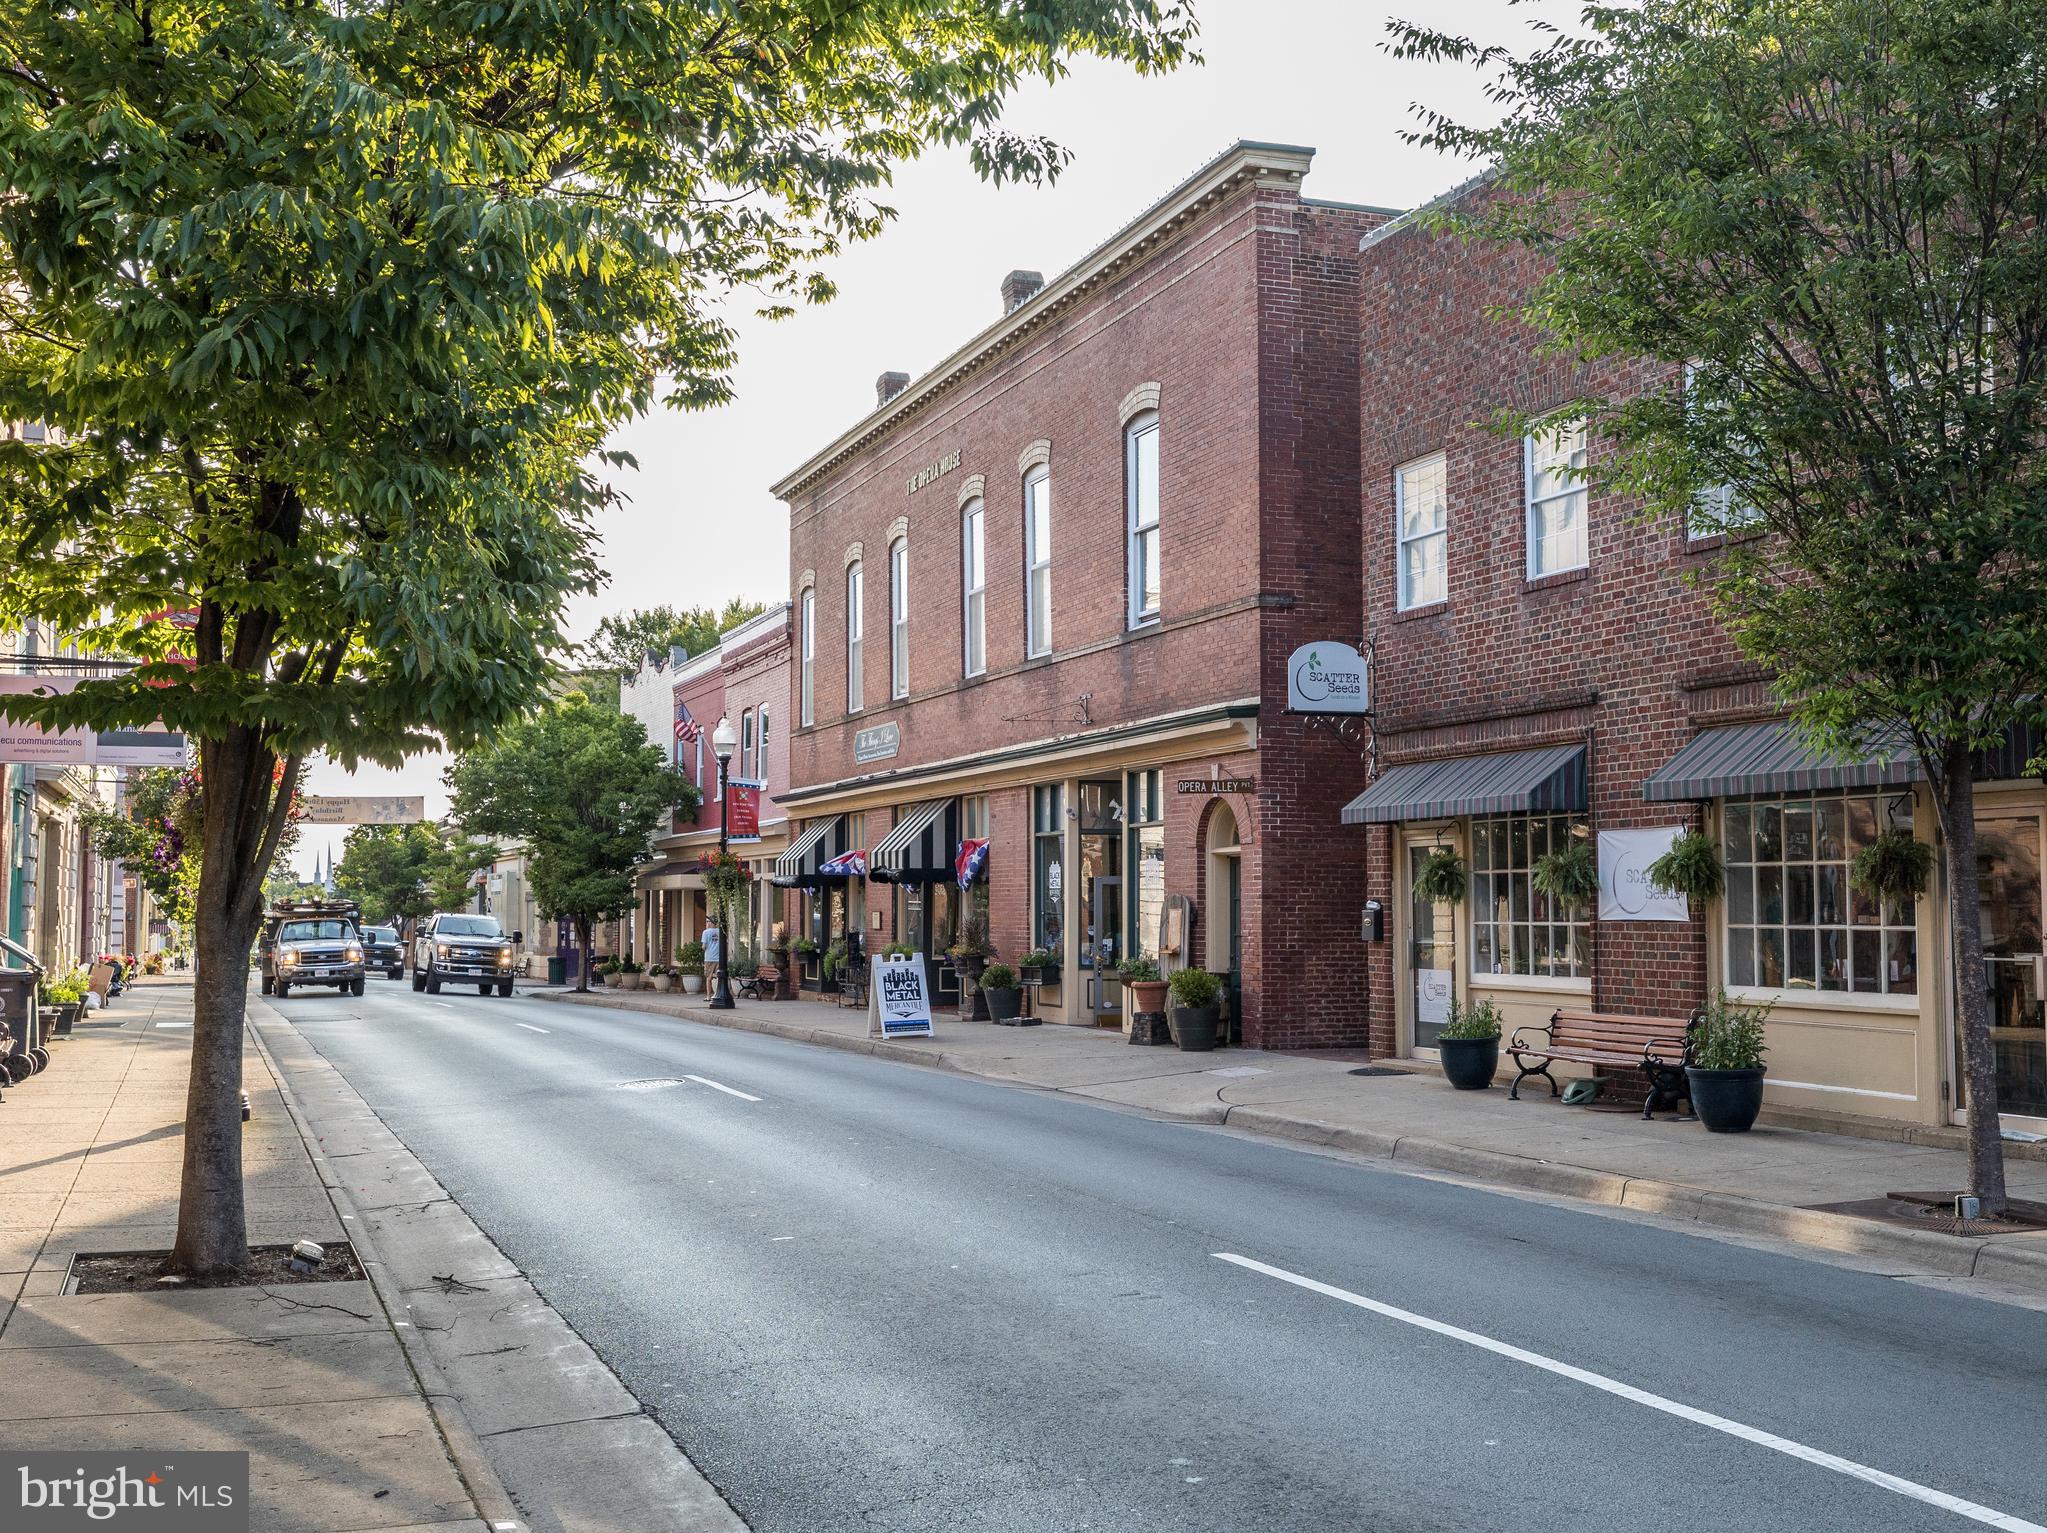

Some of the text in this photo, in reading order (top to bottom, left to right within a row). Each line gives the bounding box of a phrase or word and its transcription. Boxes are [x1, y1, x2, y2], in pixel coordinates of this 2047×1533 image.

[1309, 671, 1360, 684] SCATTER
[1327, 682, 1361, 694] Seeds
[0, 736, 82, 747] ecu communications
[1178, 781, 1207, 792] OPERA
[1211, 781, 1239, 792] ALLEY
[885, 980, 919, 991] BLACK
[886, 990, 920, 1001] METAL
[886, 1001, 923, 1013] MERCANTILE
